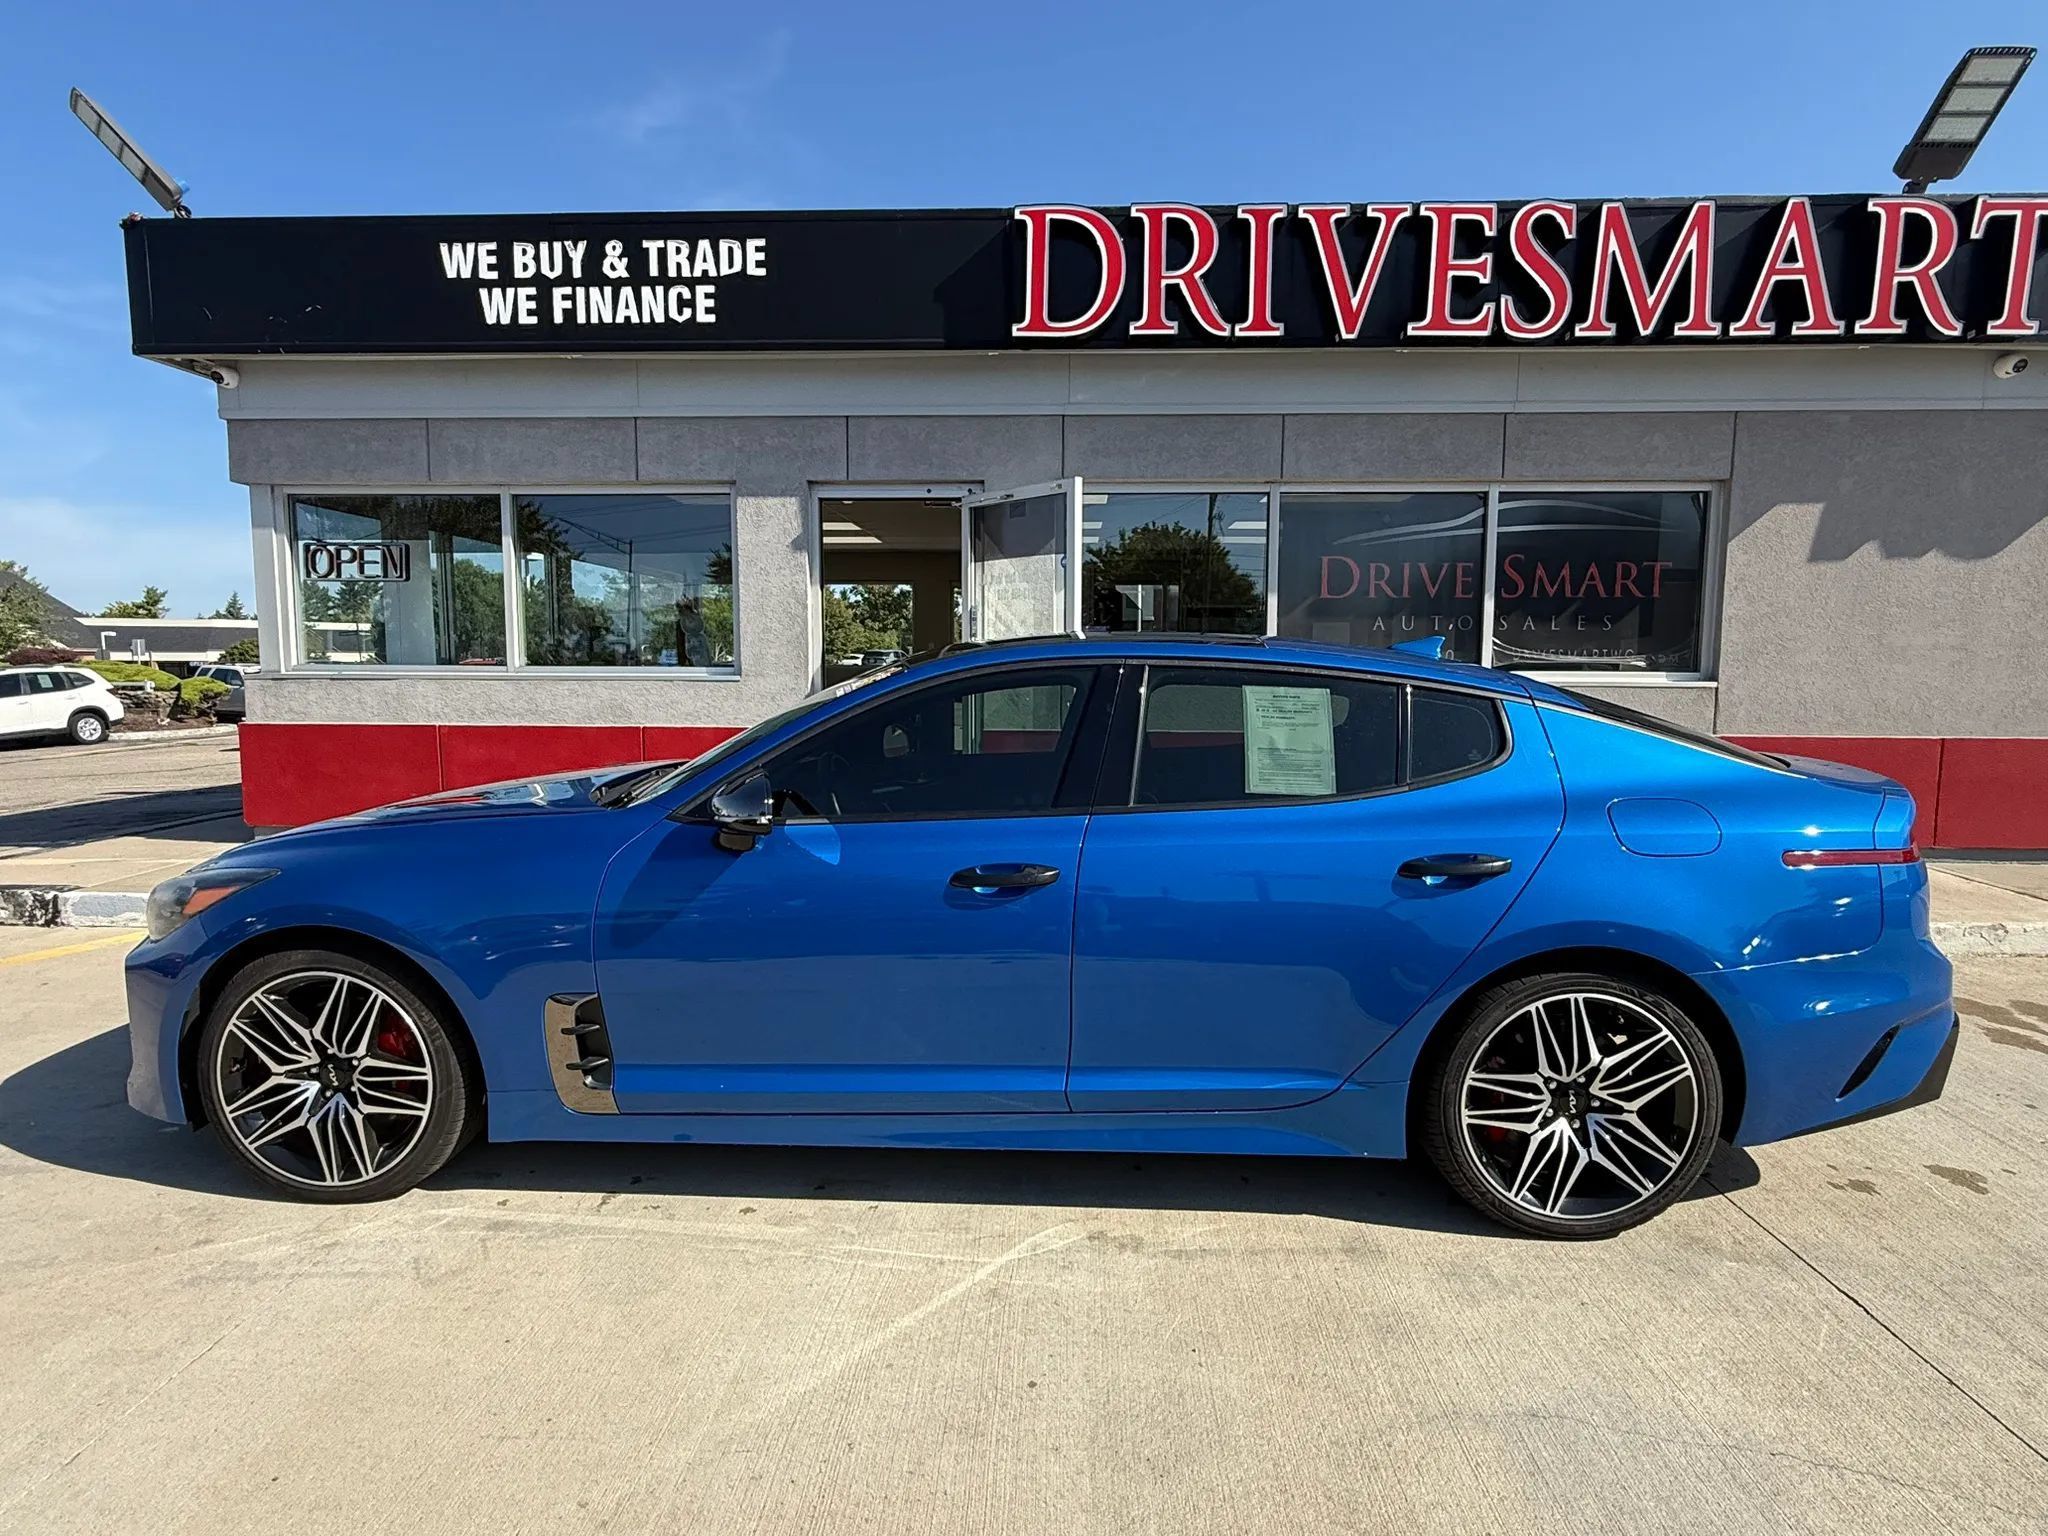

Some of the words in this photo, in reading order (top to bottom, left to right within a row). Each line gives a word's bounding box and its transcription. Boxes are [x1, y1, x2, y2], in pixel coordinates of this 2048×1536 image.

[440, 241, 498, 279] WE
[513, 240, 587, 279] BUY
[602, 239, 628, 278] &
[642, 238, 767, 277] TRADE
[1012, 195, 2048, 338] DRIVESMART
[479, 286, 538, 325] WE
[552, 284, 717, 324] FINANCE
[308, 544, 404, 579] OPEN
[1320, 555, 1475, 599] DRIVE
[1501, 553, 1673, 599] SMART
[1373, 614, 1473, 631] AUTO
[1499, 615, 1612, 631] SALES
